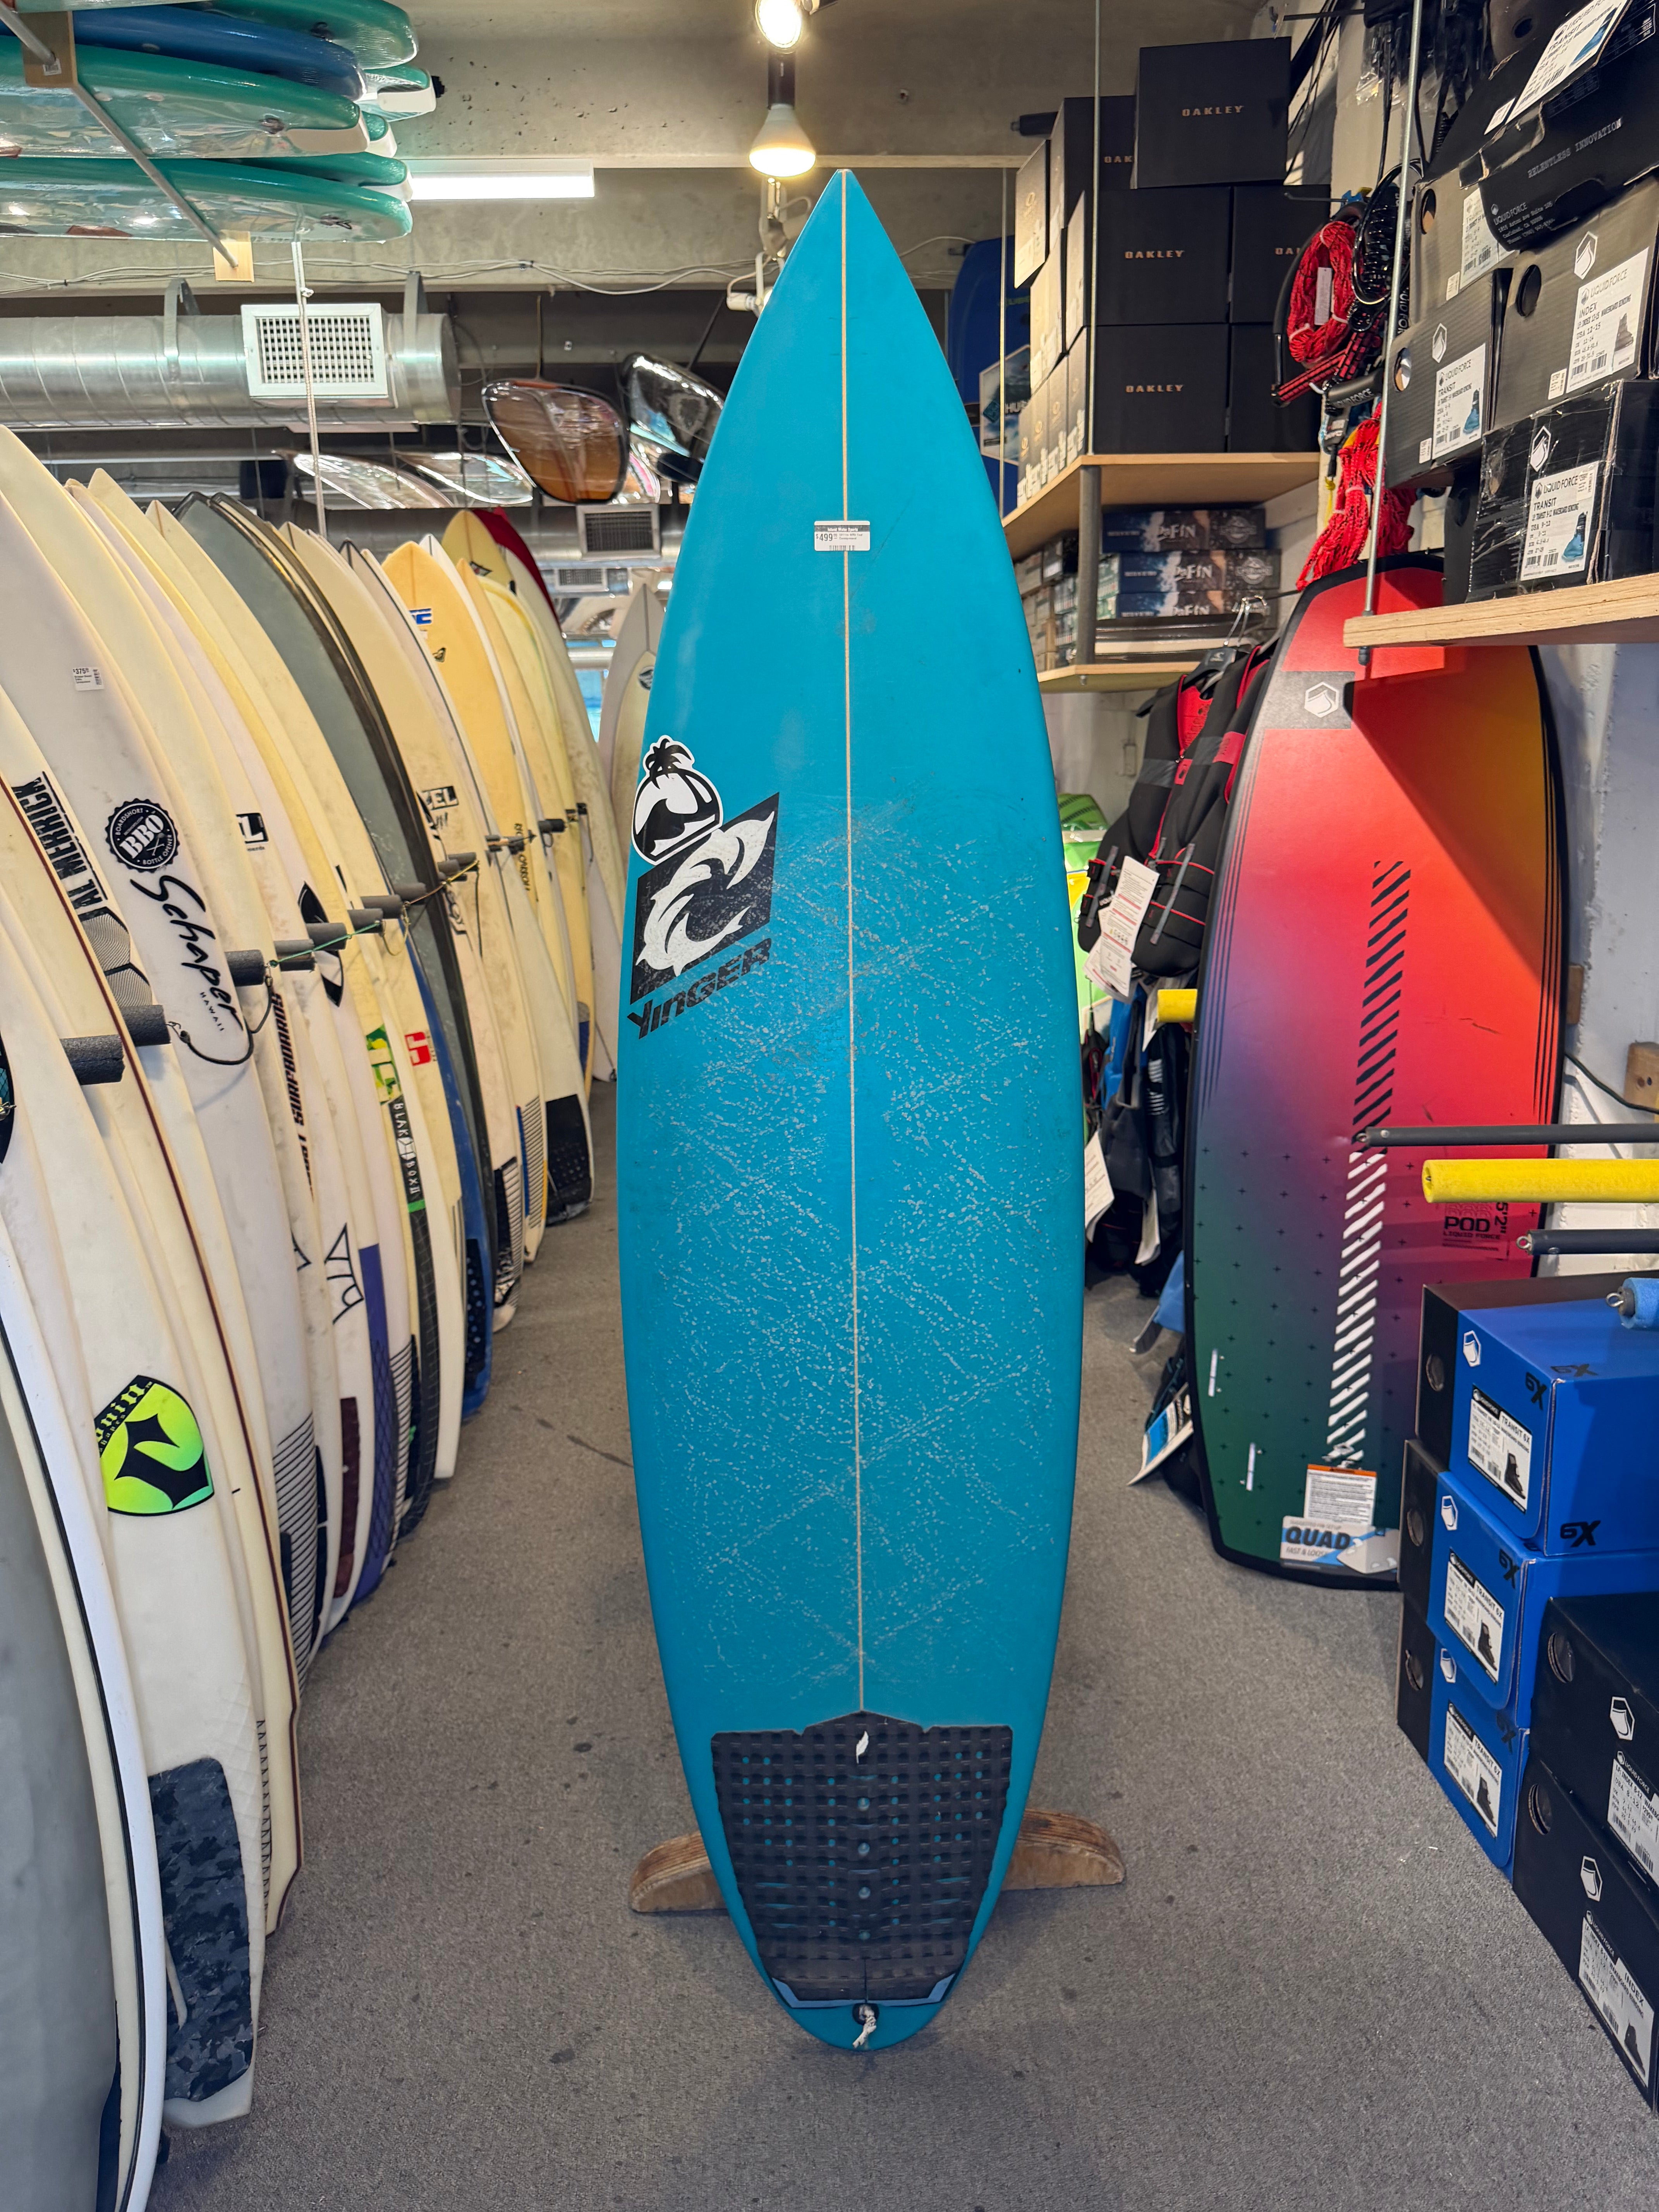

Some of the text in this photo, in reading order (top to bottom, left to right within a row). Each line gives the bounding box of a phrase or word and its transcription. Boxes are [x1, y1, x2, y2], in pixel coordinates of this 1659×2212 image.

[1182, 106, 1243, 117] OAKLEY
[1575, 117, 1623, 152] INNOVATION
[1125, 250, 1185, 259] OAKLEY
[1579, 302, 1598, 319] INDEX
[1543, 481, 1562, 494] LIQUID
[1561, 475, 1578, 489] FORCE
[1533, 497, 1557, 511] TRANSIT
[115, 808, 143, 835] BOARDSHORT
[11, 776, 104, 909] AL MERRICK
[119, 814, 164, 859] BBO
[143, 835, 173, 865] BOTTLE OPENER
[130, 875, 244, 1031] Schaper
[200, 991, 225, 1032] HAWAII
[271, 992, 304, 1126] SURFBOARDS
[393, 1101, 409, 1137] BLAK
[1444, 1216, 1490, 1232] POD
[1551, 1364, 1598, 1377] 6X
[1525, 1372, 1547, 1410] 6X
[1502, 1415, 1530, 1444] TRANSIT 6X
[1285, 1526, 1351, 1550] QUAD
[1559, 1520, 1601, 1547] 6X
[1499, 1549, 1520, 1589] 6X
[1476, 1584, 1496, 1611] TRANSIT
[1475, 1739, 1494, 1767] TRANSIT
[1621, 1770, 1633, 1788] INDEX
[1625, 1760, 1638, 1781] LIQUID
[1637, 1772, 1650, 1794] FORCE
[1625, 1972, 1644, 2007] INDEX
